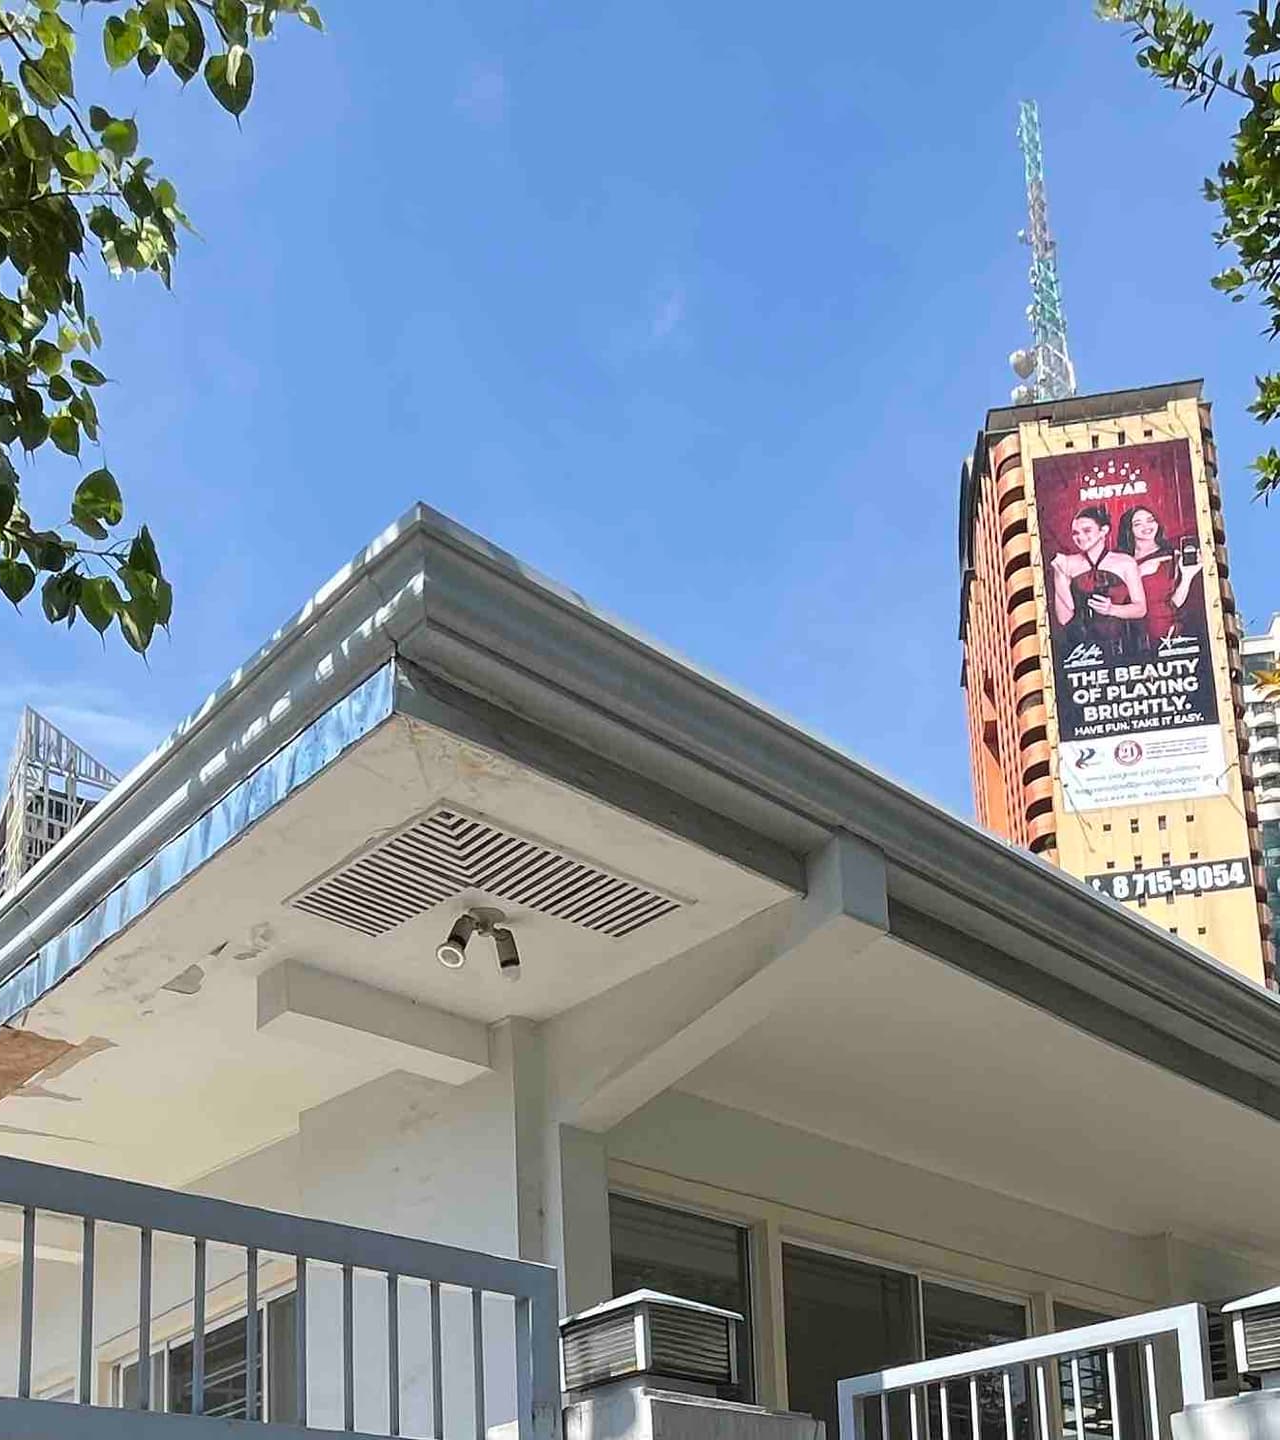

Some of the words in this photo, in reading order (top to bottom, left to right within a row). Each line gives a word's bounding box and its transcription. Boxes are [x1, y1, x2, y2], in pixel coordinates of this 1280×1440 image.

[1067, 669, 1110, 688] THE
[1114, 658, 1200, 682] BEAUTY
[1072, 688, 1102, 704] OF
[1106, 676, 1199, 701] PLAYING
[1083, 695, 1192, 722] BRIGHTLY.
[1074, 724, 1104, 736] HAVE
[1131, 717, 1160, 729] TAKE
[1161, 715, 1173, 726] IT
[1173, 712, 1205, 725] EASY.
